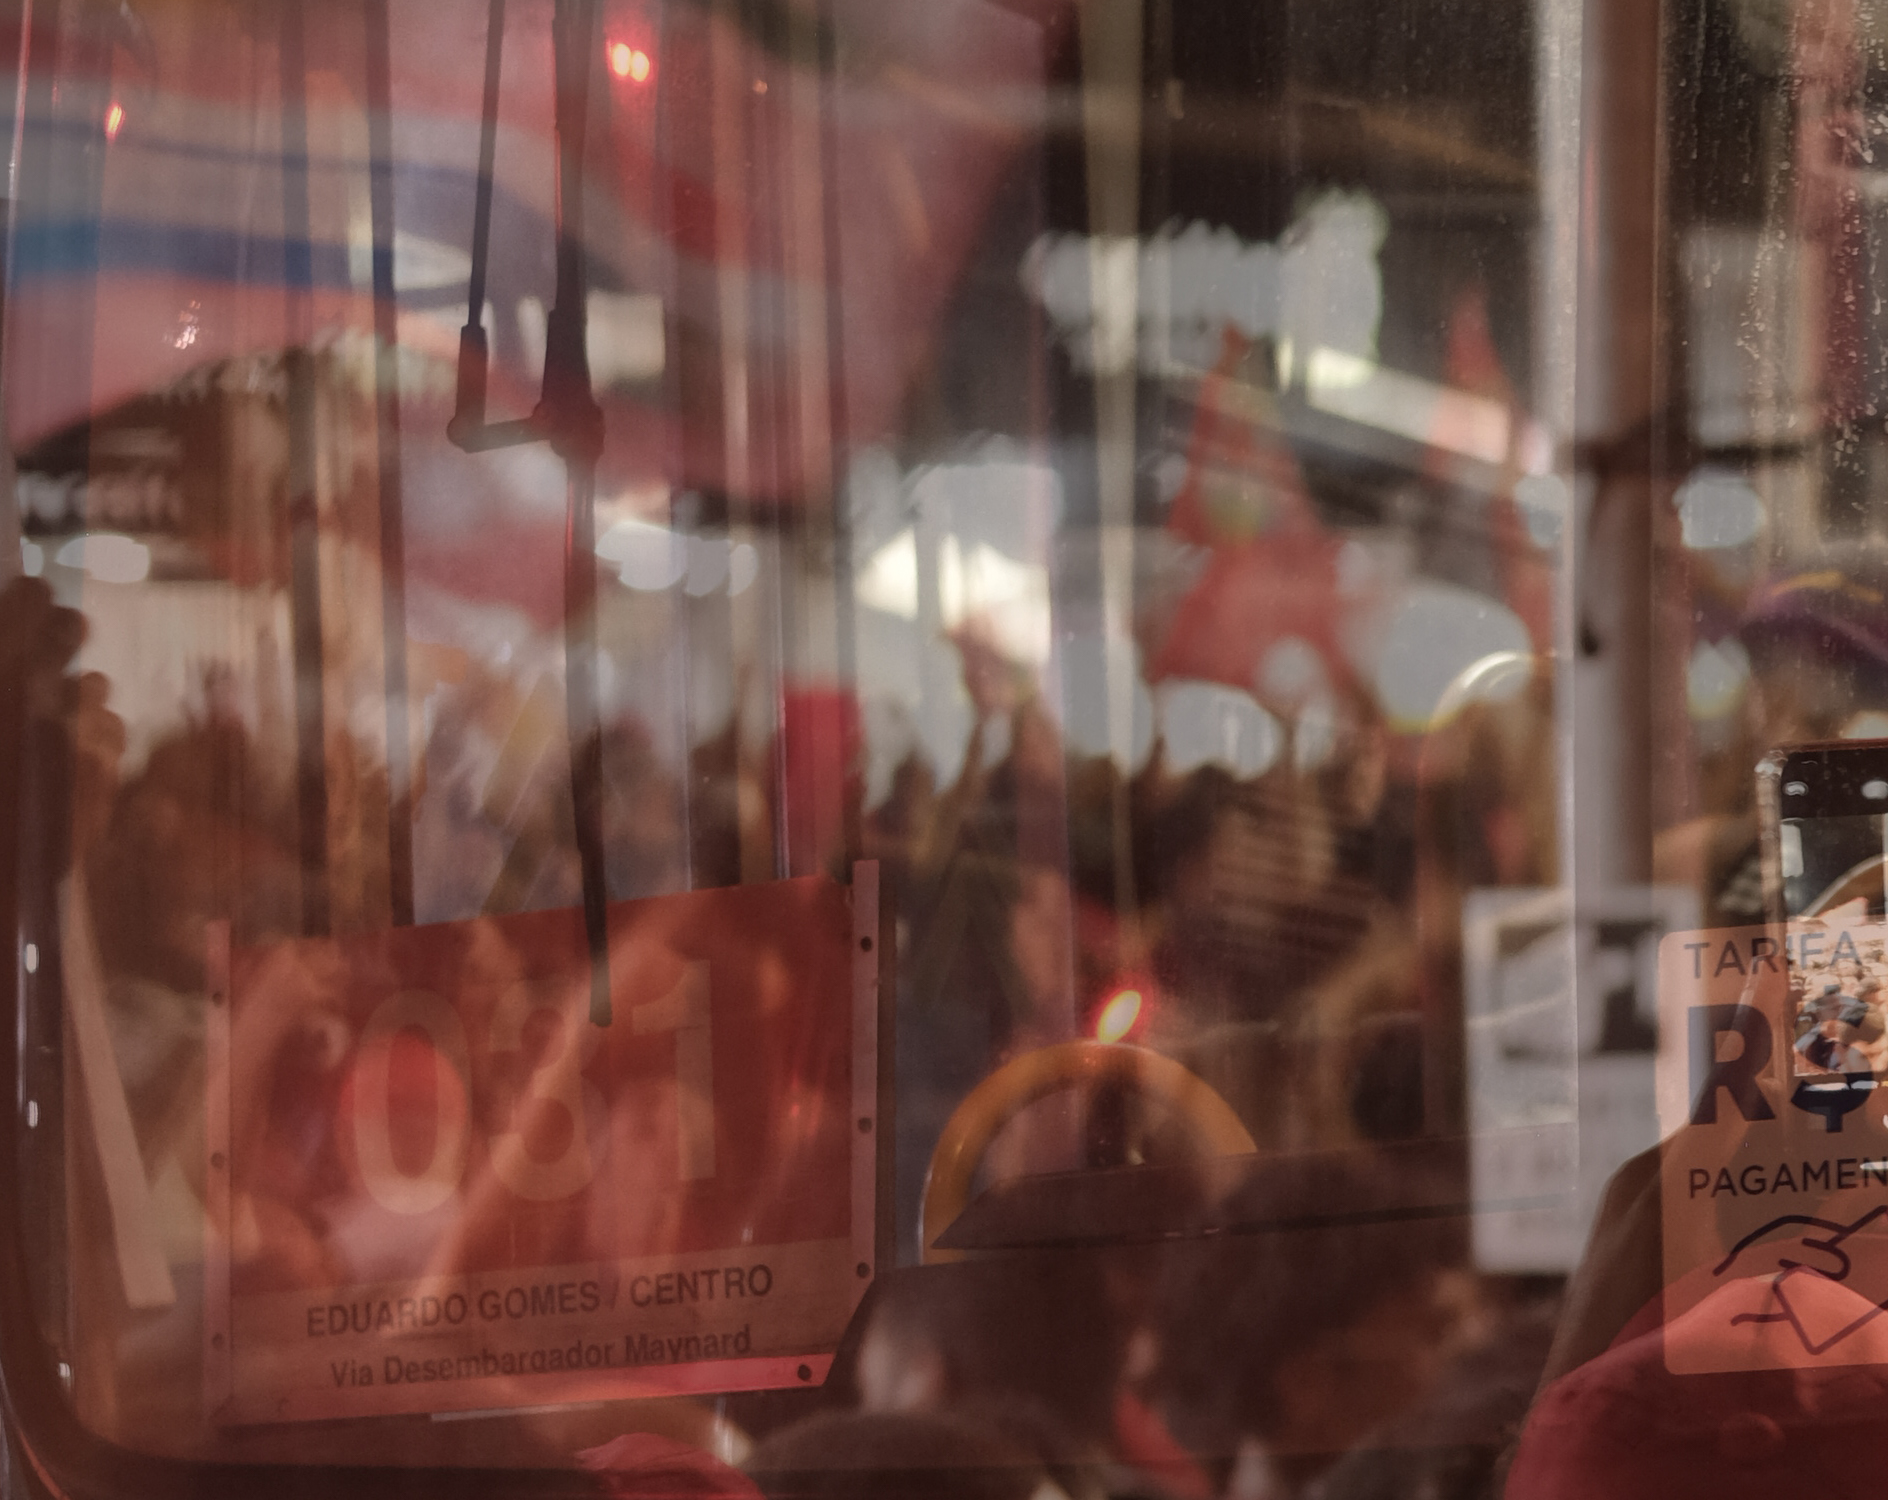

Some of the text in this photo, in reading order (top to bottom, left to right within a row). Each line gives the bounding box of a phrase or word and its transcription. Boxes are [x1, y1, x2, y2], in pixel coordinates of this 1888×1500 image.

[1685, 930, 1864, 979] TARIFA
[305, 1292, 469, 1338] EDUARDO
[477, 1280, 601, 1322] GOMES
[630, 1263, 774, 1308] CENTRO
[331, 1323, 752, 1388] Via Desembargador Maynard
